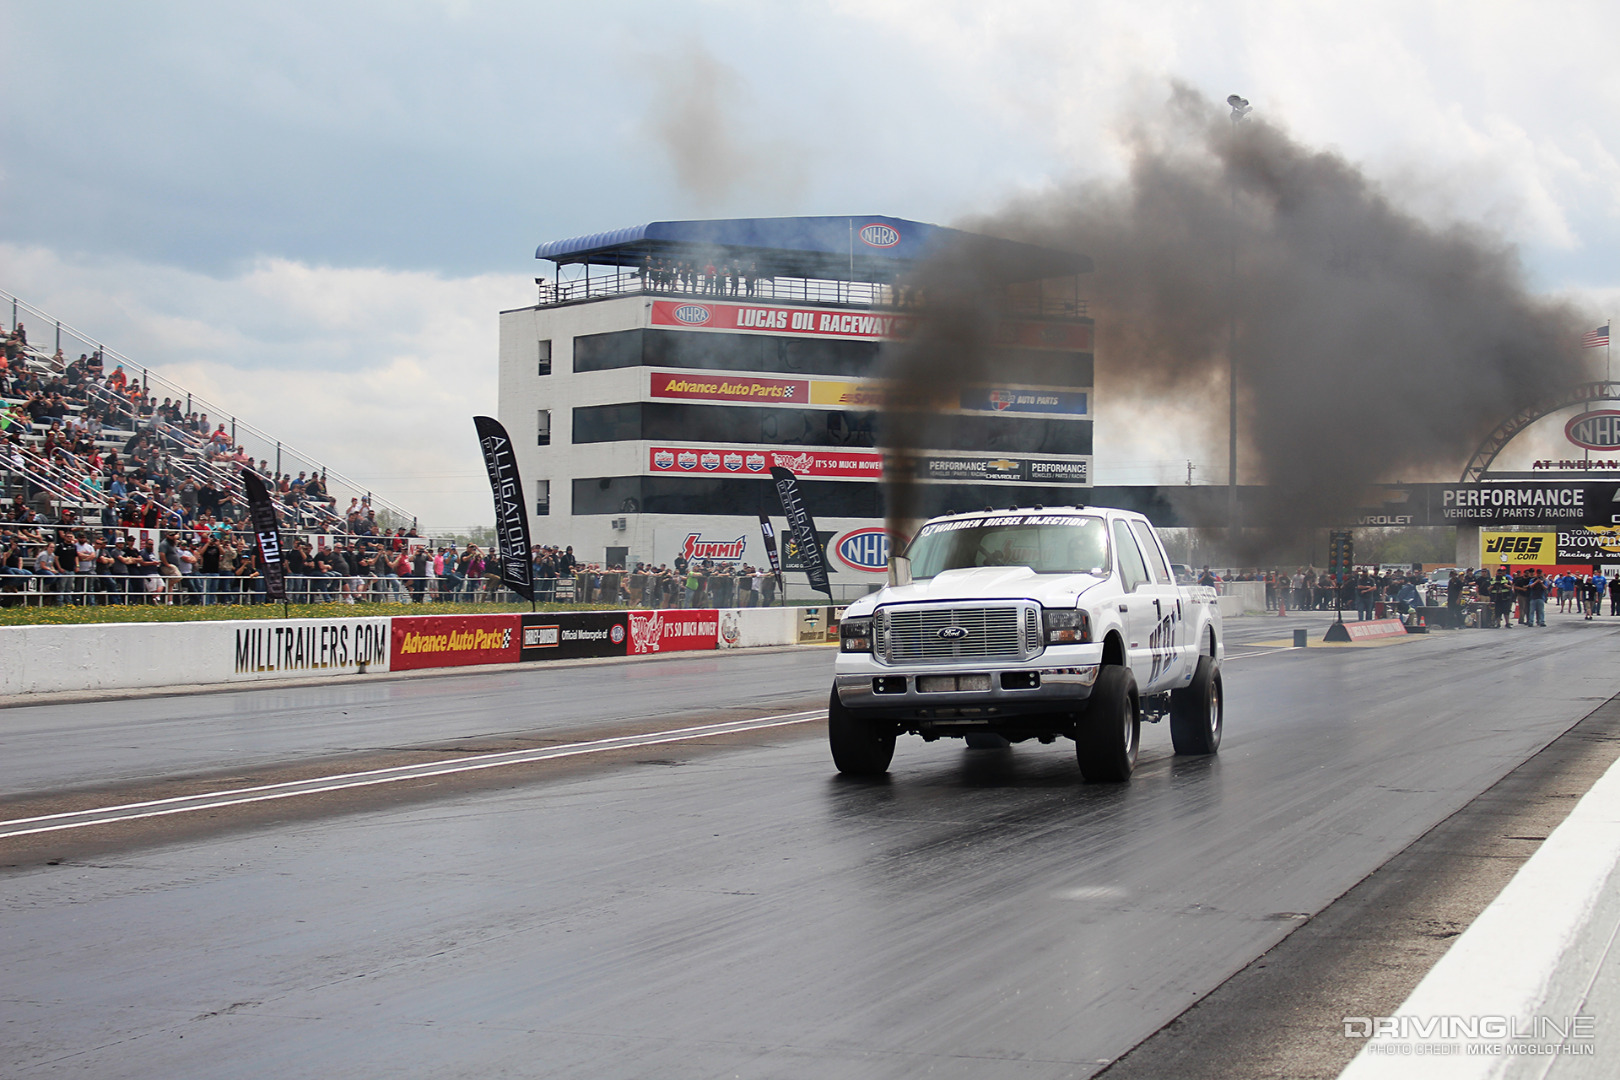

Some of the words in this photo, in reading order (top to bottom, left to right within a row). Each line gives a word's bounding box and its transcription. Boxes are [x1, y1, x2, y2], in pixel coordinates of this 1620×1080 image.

[864, 227, 897, 245] NHRA
[677, 306, 709, 322] NHRA
[737, 309, 788, 329] LUCAS
[791, 312, 815, 331] OIL
[820, 315, 892, 334] RACEWAY
[665, 379, 718, 394] Advance
[718, 381, 750, 395] Auto
[750, 384, 783, 397] Parts
[1017, 395, 1036, 404] AUTO
[1037, 396, 1059, 406] PARTS
[815, 460, 828, 468] IT'S
[828, 460, 838, 468] SO
[838, 460, 857, 469] MUCH
[858, 461, 882, 470] MOWE
[929, 461, 987, 471] PERFORMANCE
[1032, 463, 1087, 473] PERFORMANCE
[1532, 460, 1553, 469] AT
[491, 435, 526, 556] ALLIGATOR
[1443, 489, 1584, 506] PERFORMANCE
[1352, 515, 1414, 525] VROLET
[1443, 508, 1493, 518] VEHICLES
[1502, 508, 1535, 518] PARTS
[1545, 508, 1584, 518] RACING
[784, 479, 821, 566] ALLIGATOR
[934, 518, 984, 533] WARREN
[983, 516, 1024, 527] DIESEL
[1024, 516, 1090, 528] INJECTION
[848, 534, 891, 565] NHR
[1486, 536, 1544, 553] JEGS
[1558, 549, 1592, 559] Racing
[1594, 550, 1604, 558] is
[561, 629, 578, 640] Official
[578, 629, 600, 641] Motorcycle
[600, 629, 608, 639] of
[663, 622, 674, 638] IT'S
[674, 622, 682, 637] SO
[682, 621, 697, 637] MUCH
[697, 621, 718, 636] MOWER
[235, 624, 386, 674] MILLTRAILERS.COM
[401, 632, 447, 655] Advance
[446, 629, 476, 651] Auto
[474, 628, 504, 649] Parts
